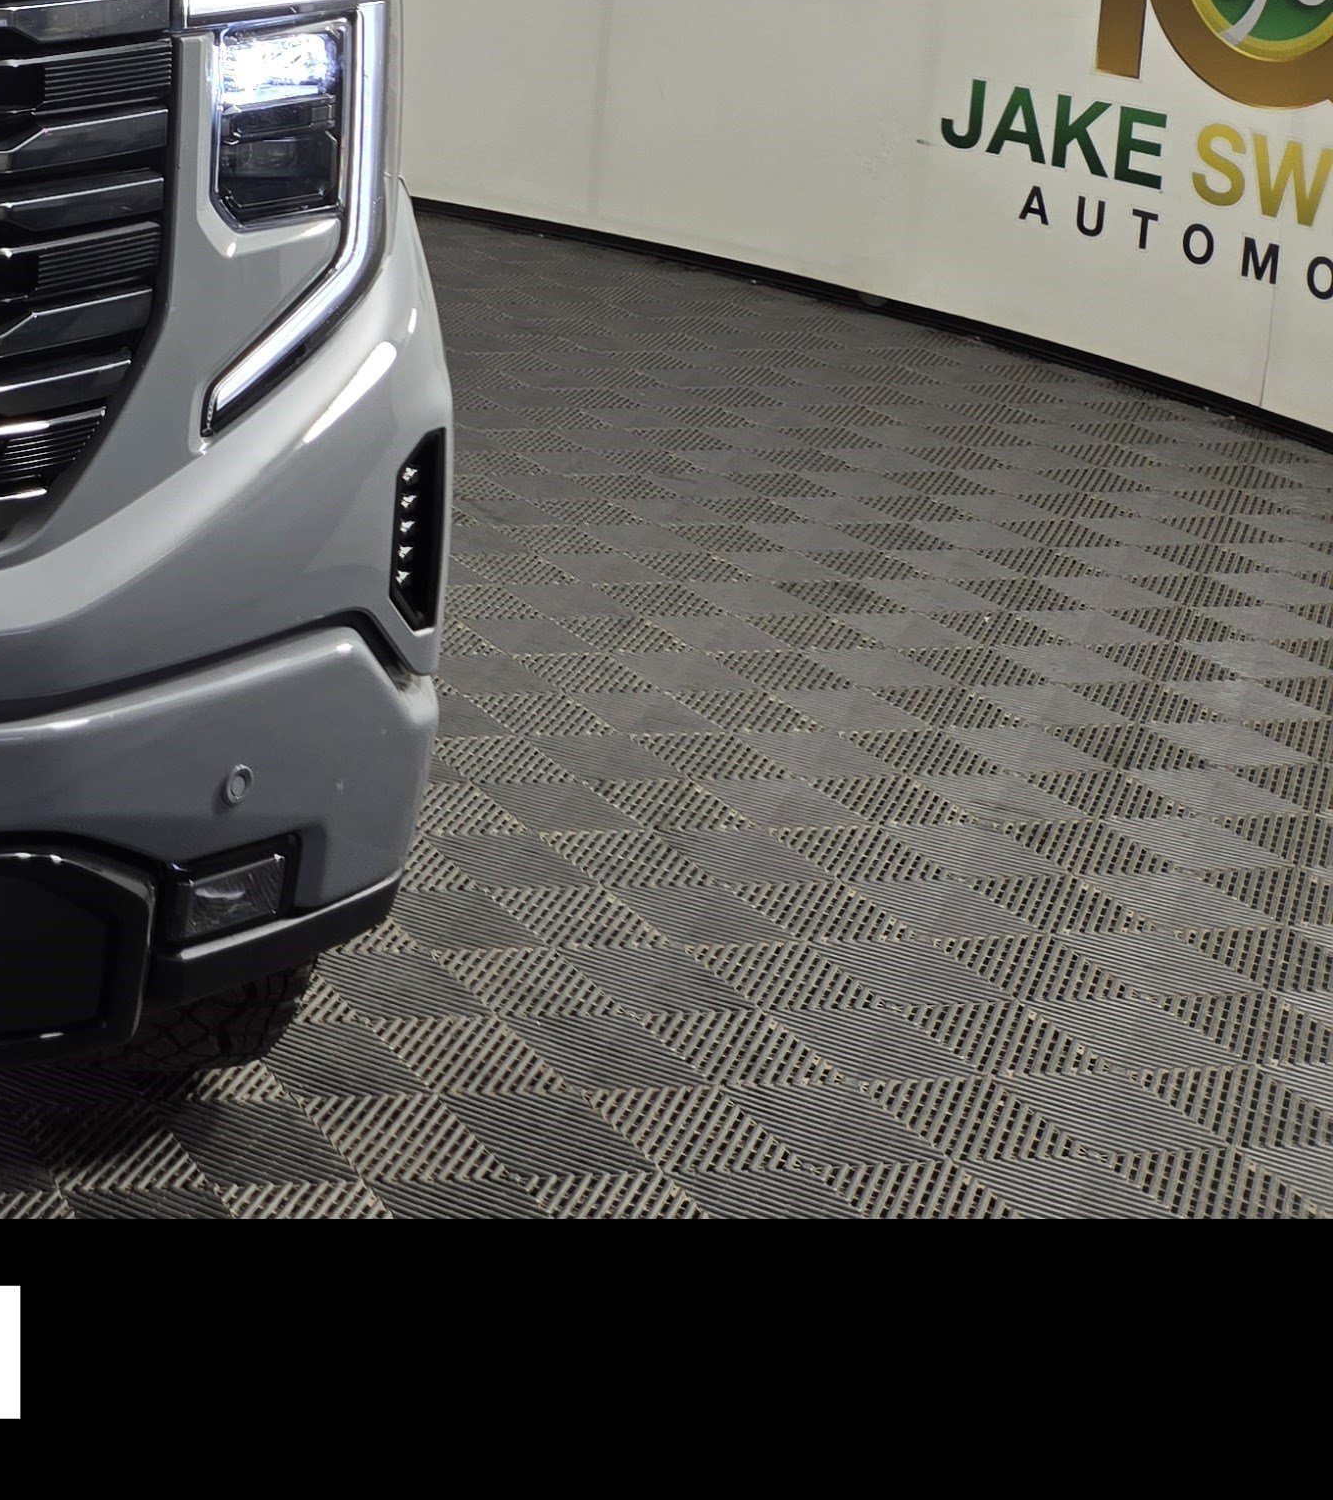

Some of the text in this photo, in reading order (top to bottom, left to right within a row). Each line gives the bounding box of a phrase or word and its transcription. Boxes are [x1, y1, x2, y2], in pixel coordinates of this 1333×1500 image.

[941, 78, 1333, 227] JAKE SW
[1018, 185, 1333, 300] AUTOMO
